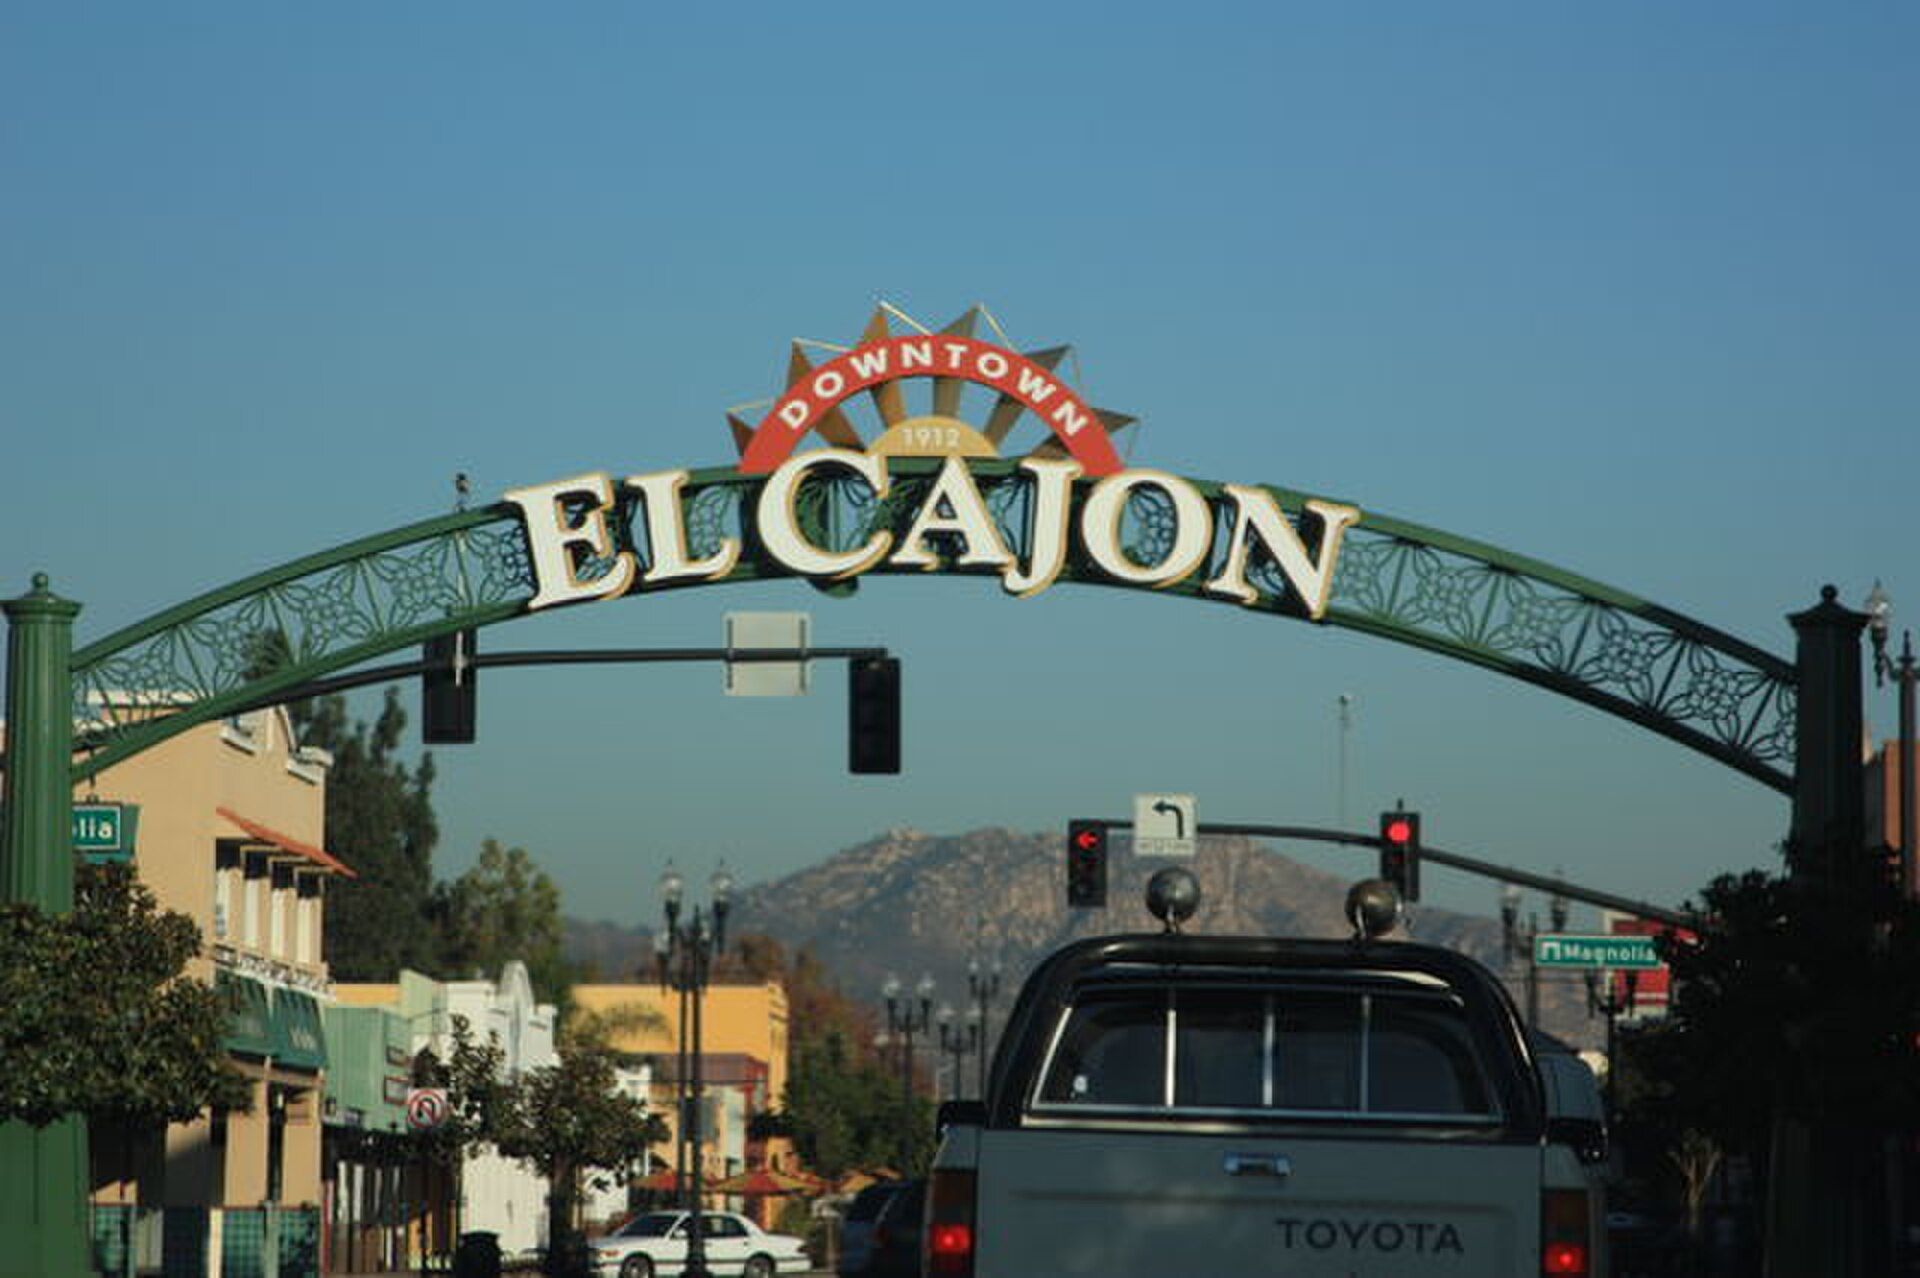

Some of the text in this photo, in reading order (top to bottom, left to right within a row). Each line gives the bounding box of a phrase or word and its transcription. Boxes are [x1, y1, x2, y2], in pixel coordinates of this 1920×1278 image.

[778, 341, 1089, 438] DOWNTOWN
[901, 426, 960, 448] 1912
[505, 449, 1359, 619] EL CAJON
[1564, 944, 1657, 966] Magnolia
[1275, 1218, 1464, 1254] TOYOTA
